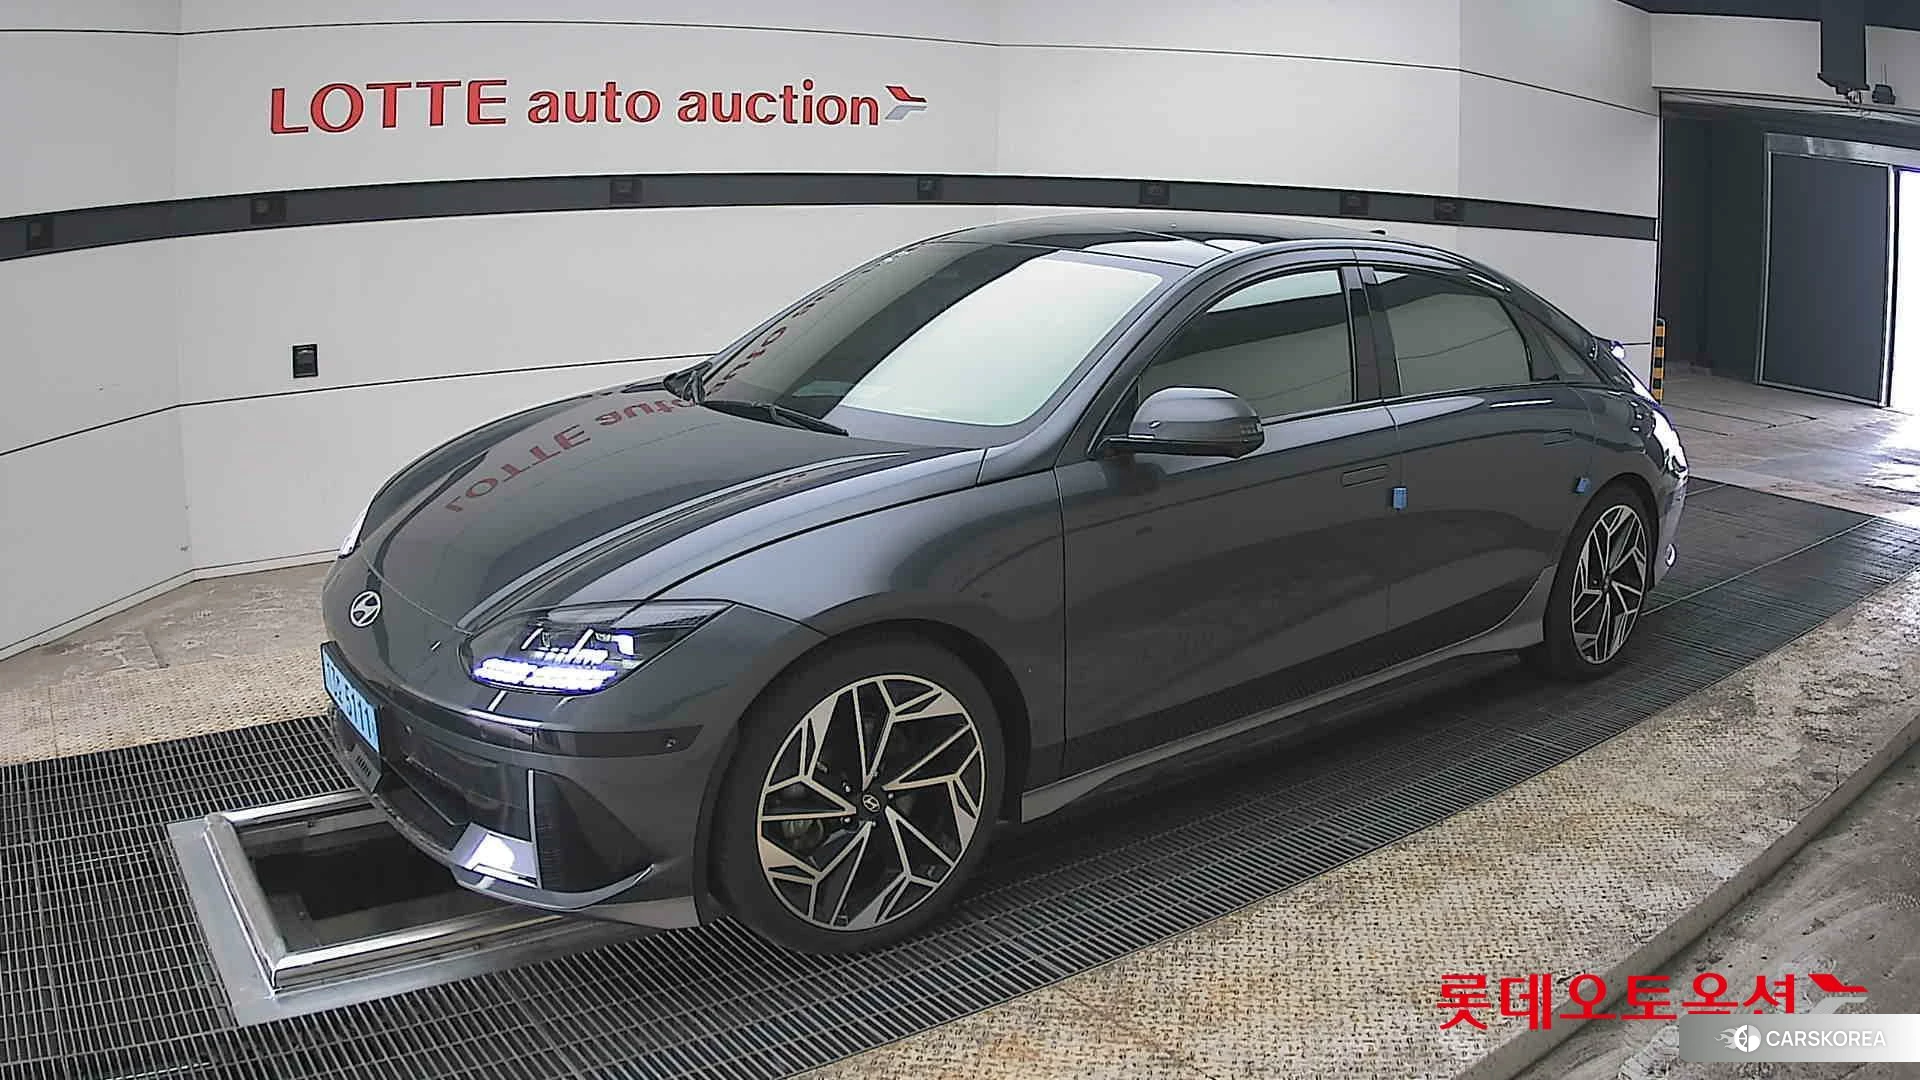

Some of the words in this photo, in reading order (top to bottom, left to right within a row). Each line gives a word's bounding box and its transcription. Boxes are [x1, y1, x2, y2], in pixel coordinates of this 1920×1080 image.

[269, 79, 507, 135] LOTTE
[527, 81, 661, 124] auto
[677, 78, 879, 126] auction
